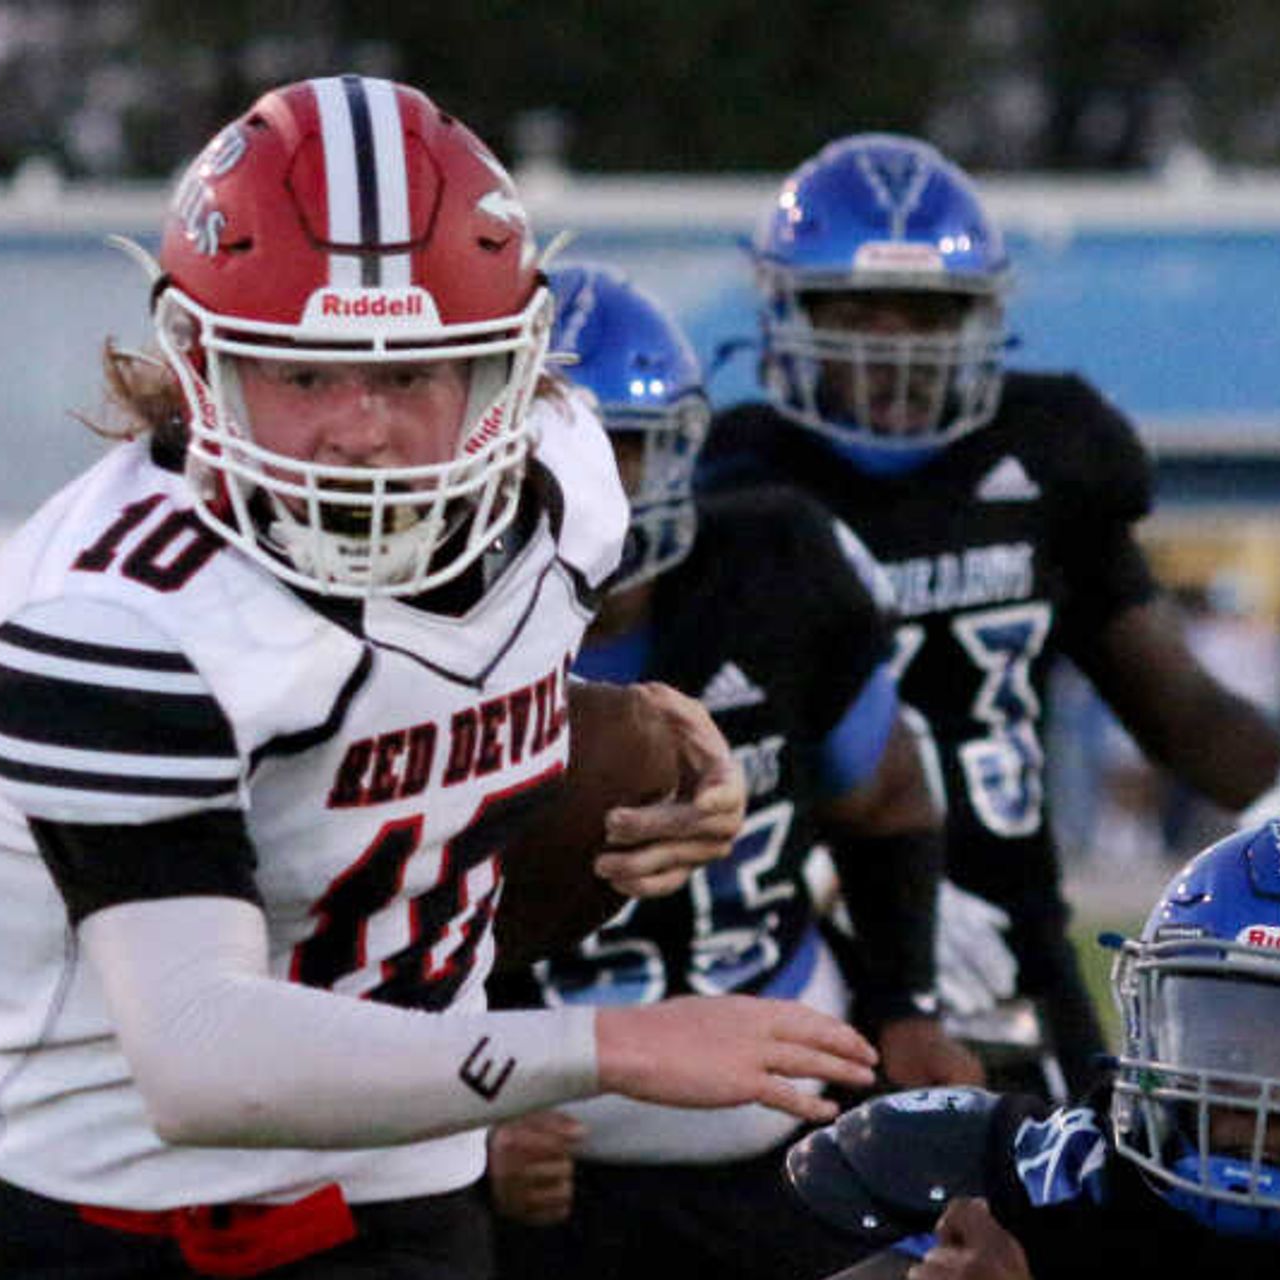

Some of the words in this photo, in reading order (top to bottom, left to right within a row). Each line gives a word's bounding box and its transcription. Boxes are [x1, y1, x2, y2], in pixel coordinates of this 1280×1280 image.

[323, 294, 422, 316] Riddell
[69, 492, 229, 592] 10
[325, 720, 438, 808] RED
[441, 654, 570, 787] DEVIL
[288, 760, 565, 1012] 10
